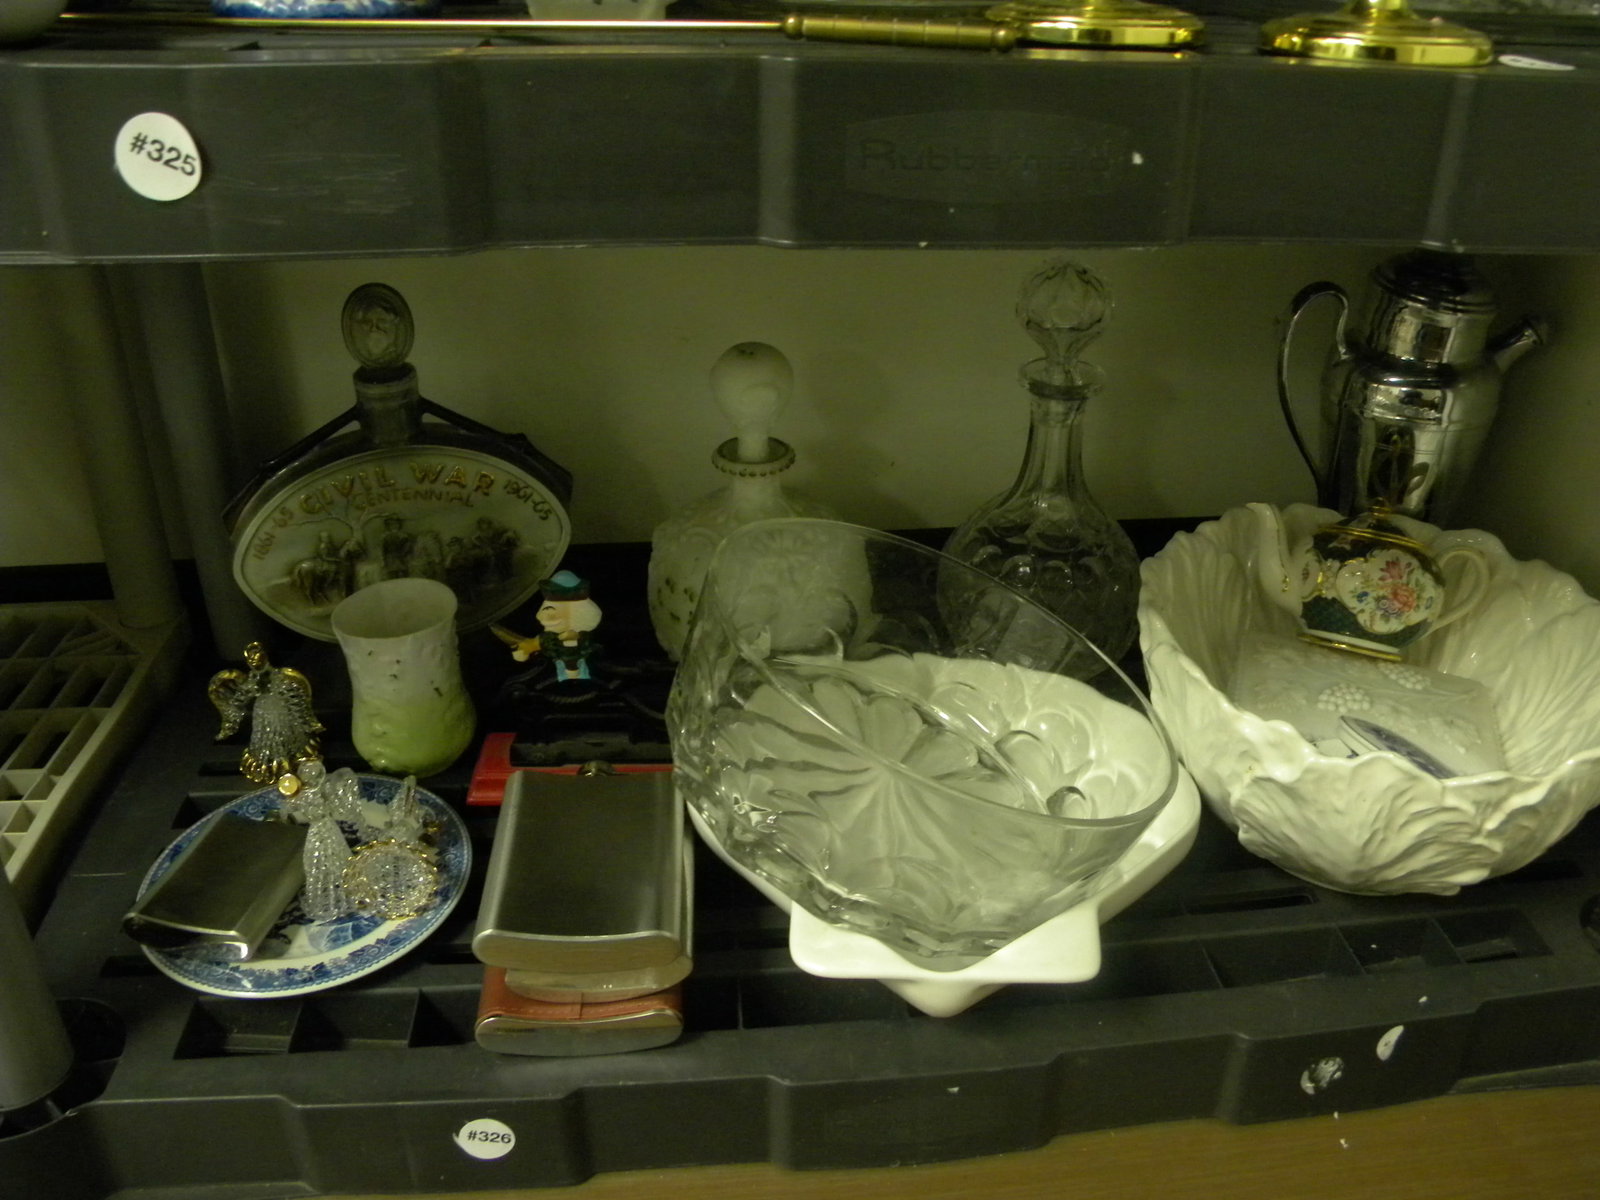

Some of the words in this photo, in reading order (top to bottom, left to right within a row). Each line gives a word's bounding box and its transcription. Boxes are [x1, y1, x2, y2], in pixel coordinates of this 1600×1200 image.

[130, 132, 196, 176] #325
[299, 464, 396, 515] CIVIL
[410, 462, 495, 497] WAR
[355, 487, 474, 510] CENTENNIAL
[467, 1130, 511, 1144] #326
